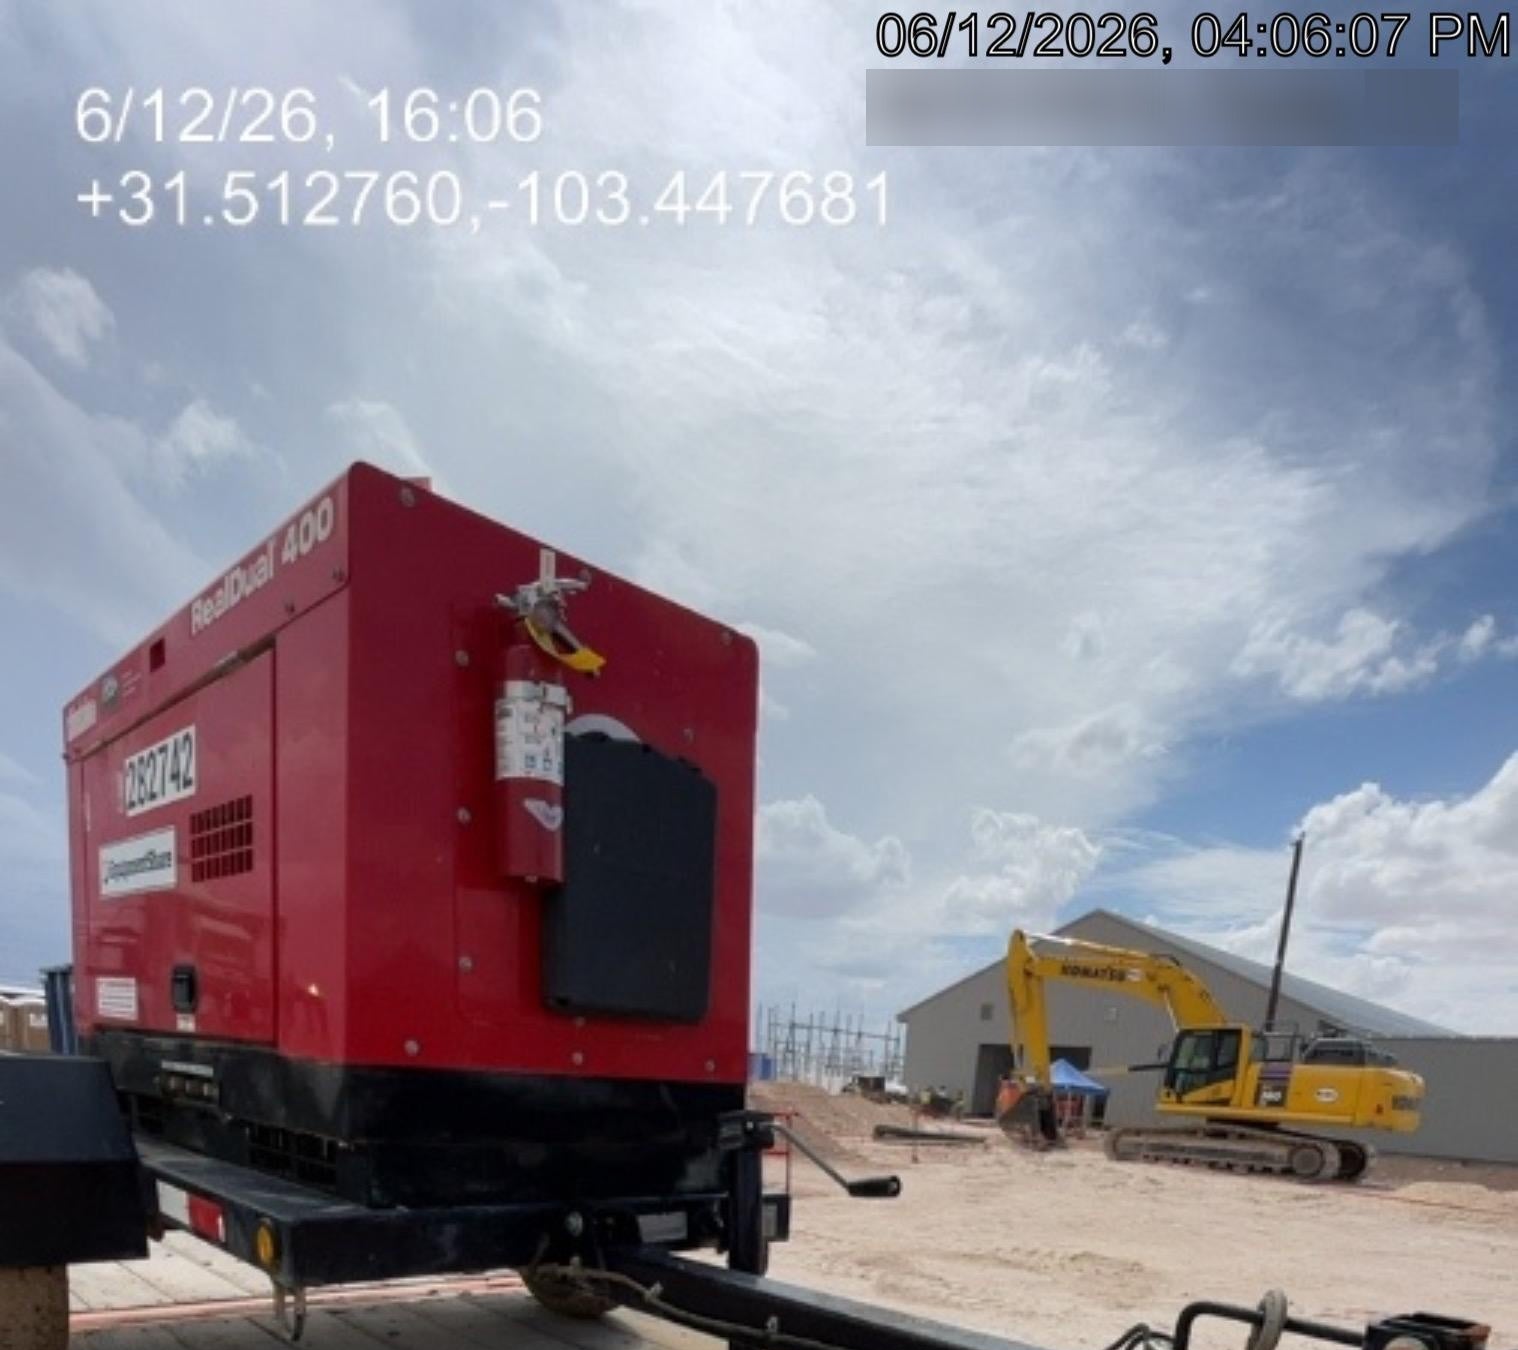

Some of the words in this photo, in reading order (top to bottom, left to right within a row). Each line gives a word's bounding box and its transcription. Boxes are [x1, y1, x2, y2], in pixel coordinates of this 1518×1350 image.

[190, 539, 274, 635] RealDual
[282, 496, 334, 564] 400
[128, 731, 193, 810] 282742
[1061, 964, 1126, 982] KOMATSU
